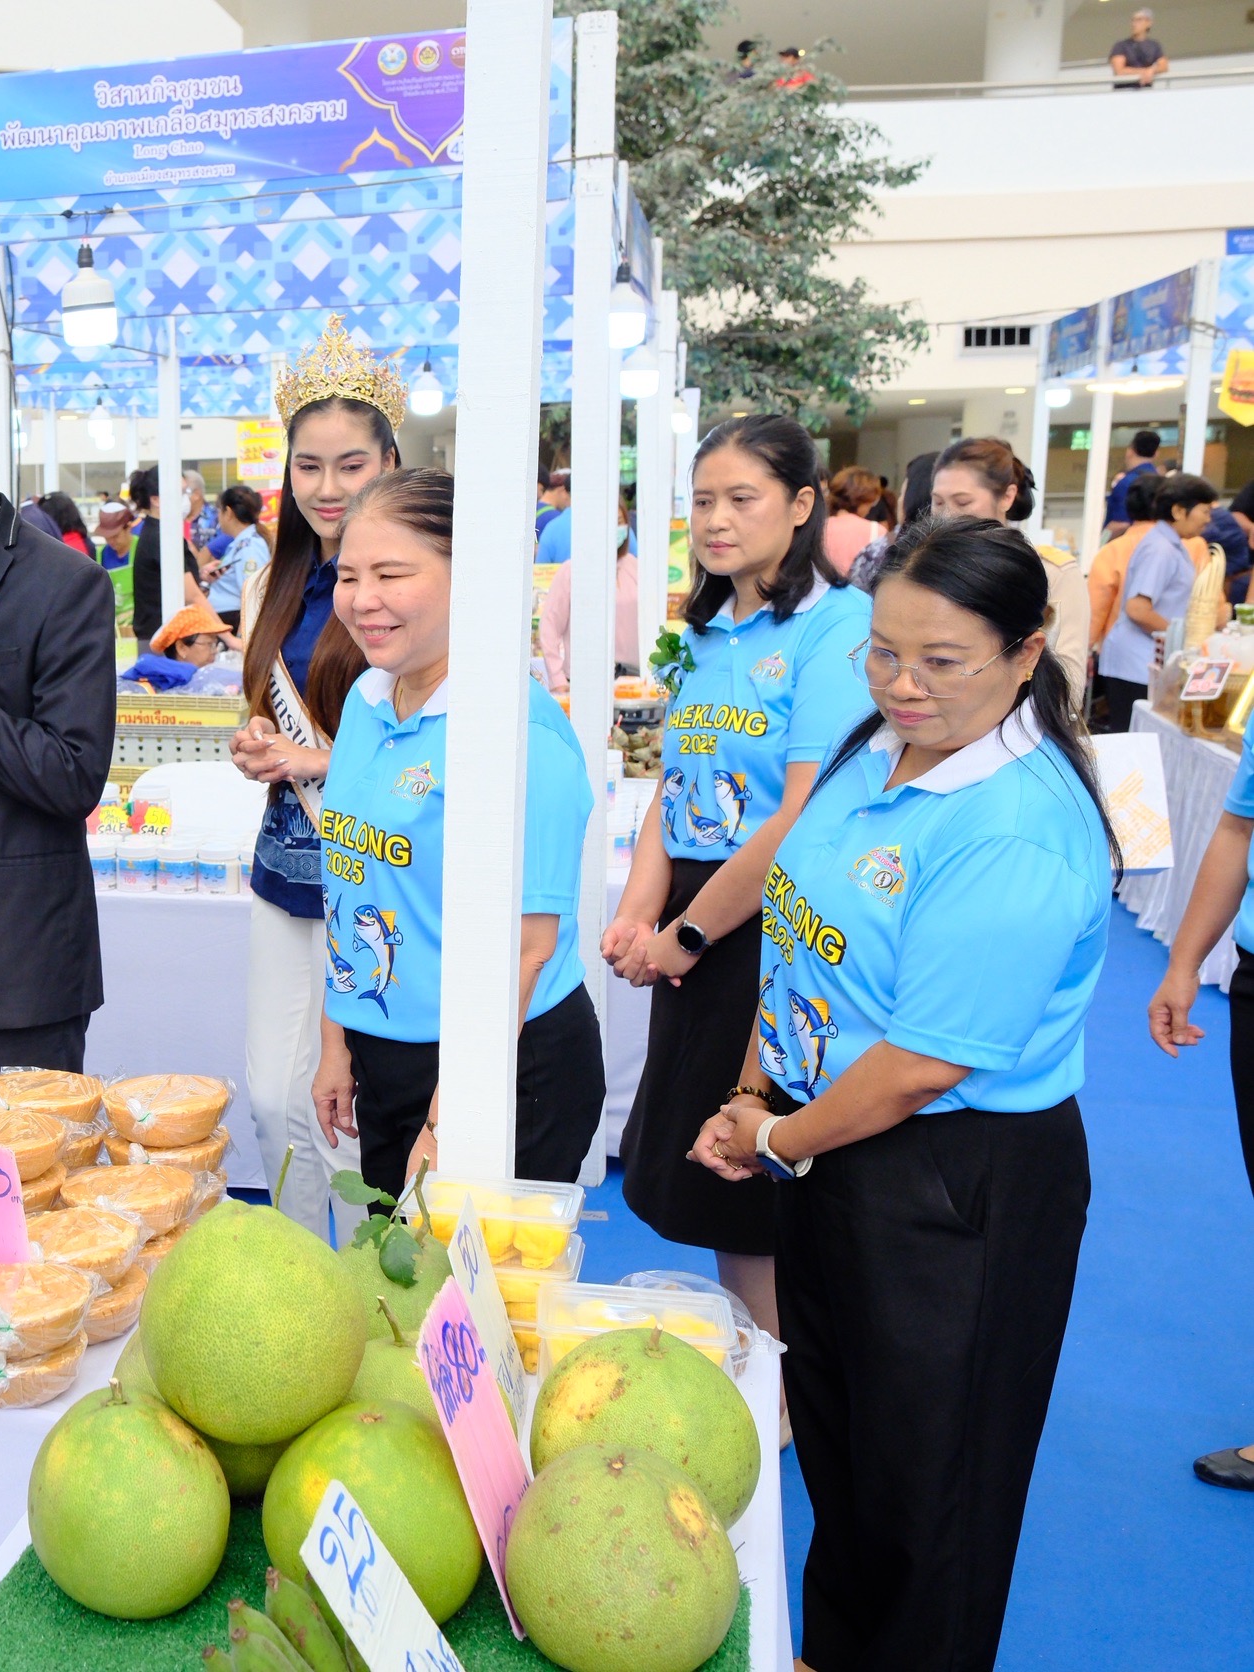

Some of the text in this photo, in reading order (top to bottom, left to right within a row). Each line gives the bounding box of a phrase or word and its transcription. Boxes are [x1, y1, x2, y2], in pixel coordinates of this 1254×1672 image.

[95, 75, 242, 109] วิสาหกิจชุมชน
[0, 99, 347, 152] พัฒนาคุณภาพเกลือสมุทรสงคราม
[133, 141, 204, 160] Long Chao
[679, 733, 718, 756] 2025
[98, 821, 125, 835] SALE
[140, 824, 168, 836] SALE
[325, 848, 366, 885] 2025
[763, 858, 847, 967] EKLONG
[762, 905, 795, 966] 2025
[318, 1491, 376, 1596] 25
